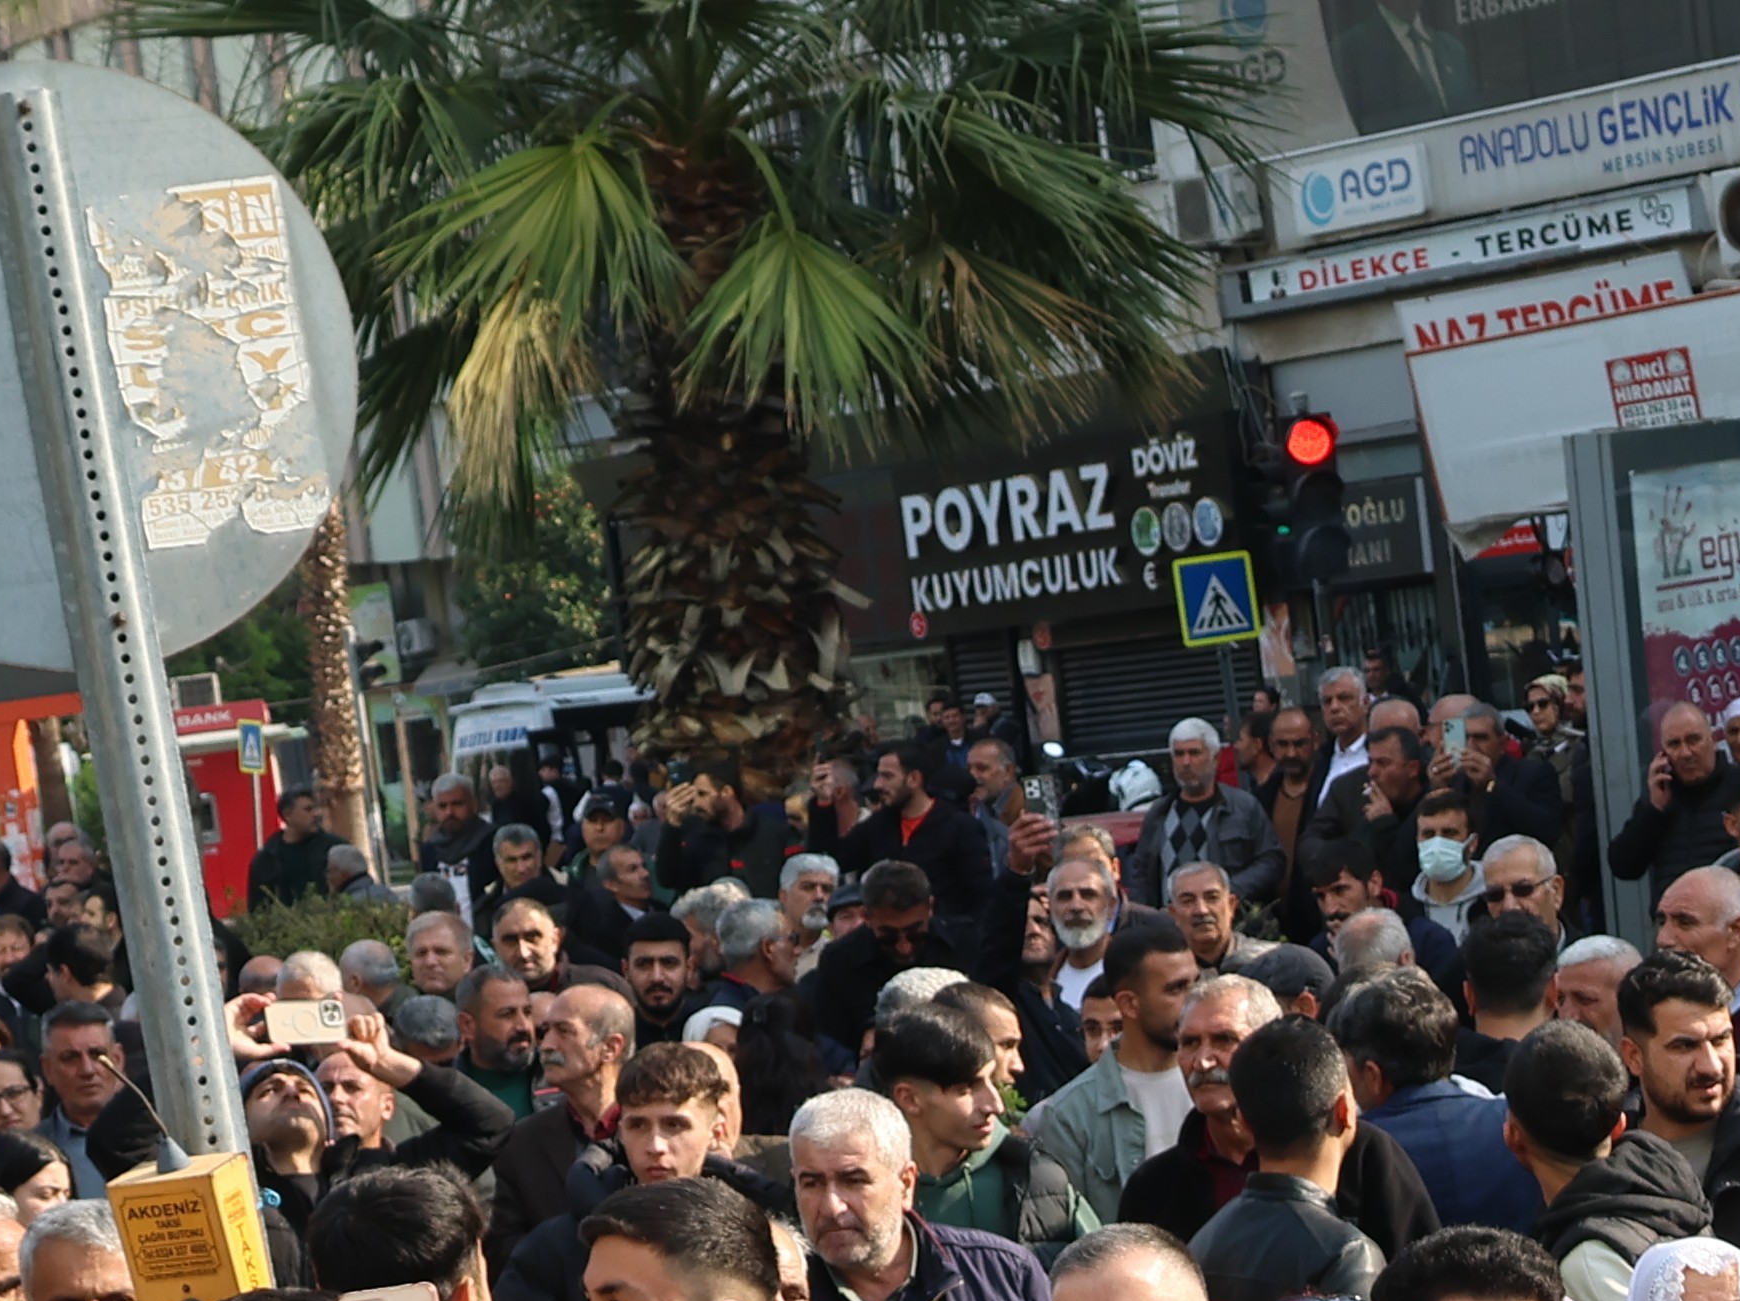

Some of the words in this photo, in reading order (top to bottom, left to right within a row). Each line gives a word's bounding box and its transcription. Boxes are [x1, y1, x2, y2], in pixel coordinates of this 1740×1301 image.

[1461, 111, 1590, 175] ANADOLU
[1598, 83, 1732, 146] GENÇLİK
[1602, 145, 1662, 174] MERSİN
[1666, 134, 1724, 165] ŞUBESİ
[1340, 157, 1412, 203] AGD
[201, 190, 276, 234] SİN
[1299, 247, 1429, 291] DİLEKÇE
[1476, 202, 1635, 258] TERCÜME
[1414, 313, 1488, 349] NAZ
[1613, 375, 1692, 404] HIRDAVAT
[1131, 432, 1199, 478] DÖVİZ
[900, 461, 1117, 560] POYRAZ
[1345, 496, 1405, 528] OĞLU
[910, 546, 1123, 614] KUYUMCULUK
[176, 709, 232, 728] BANK
[128, 1198, 202, 1221] AKDENİZ
[236, 1221, 259, 1290] TAKS
